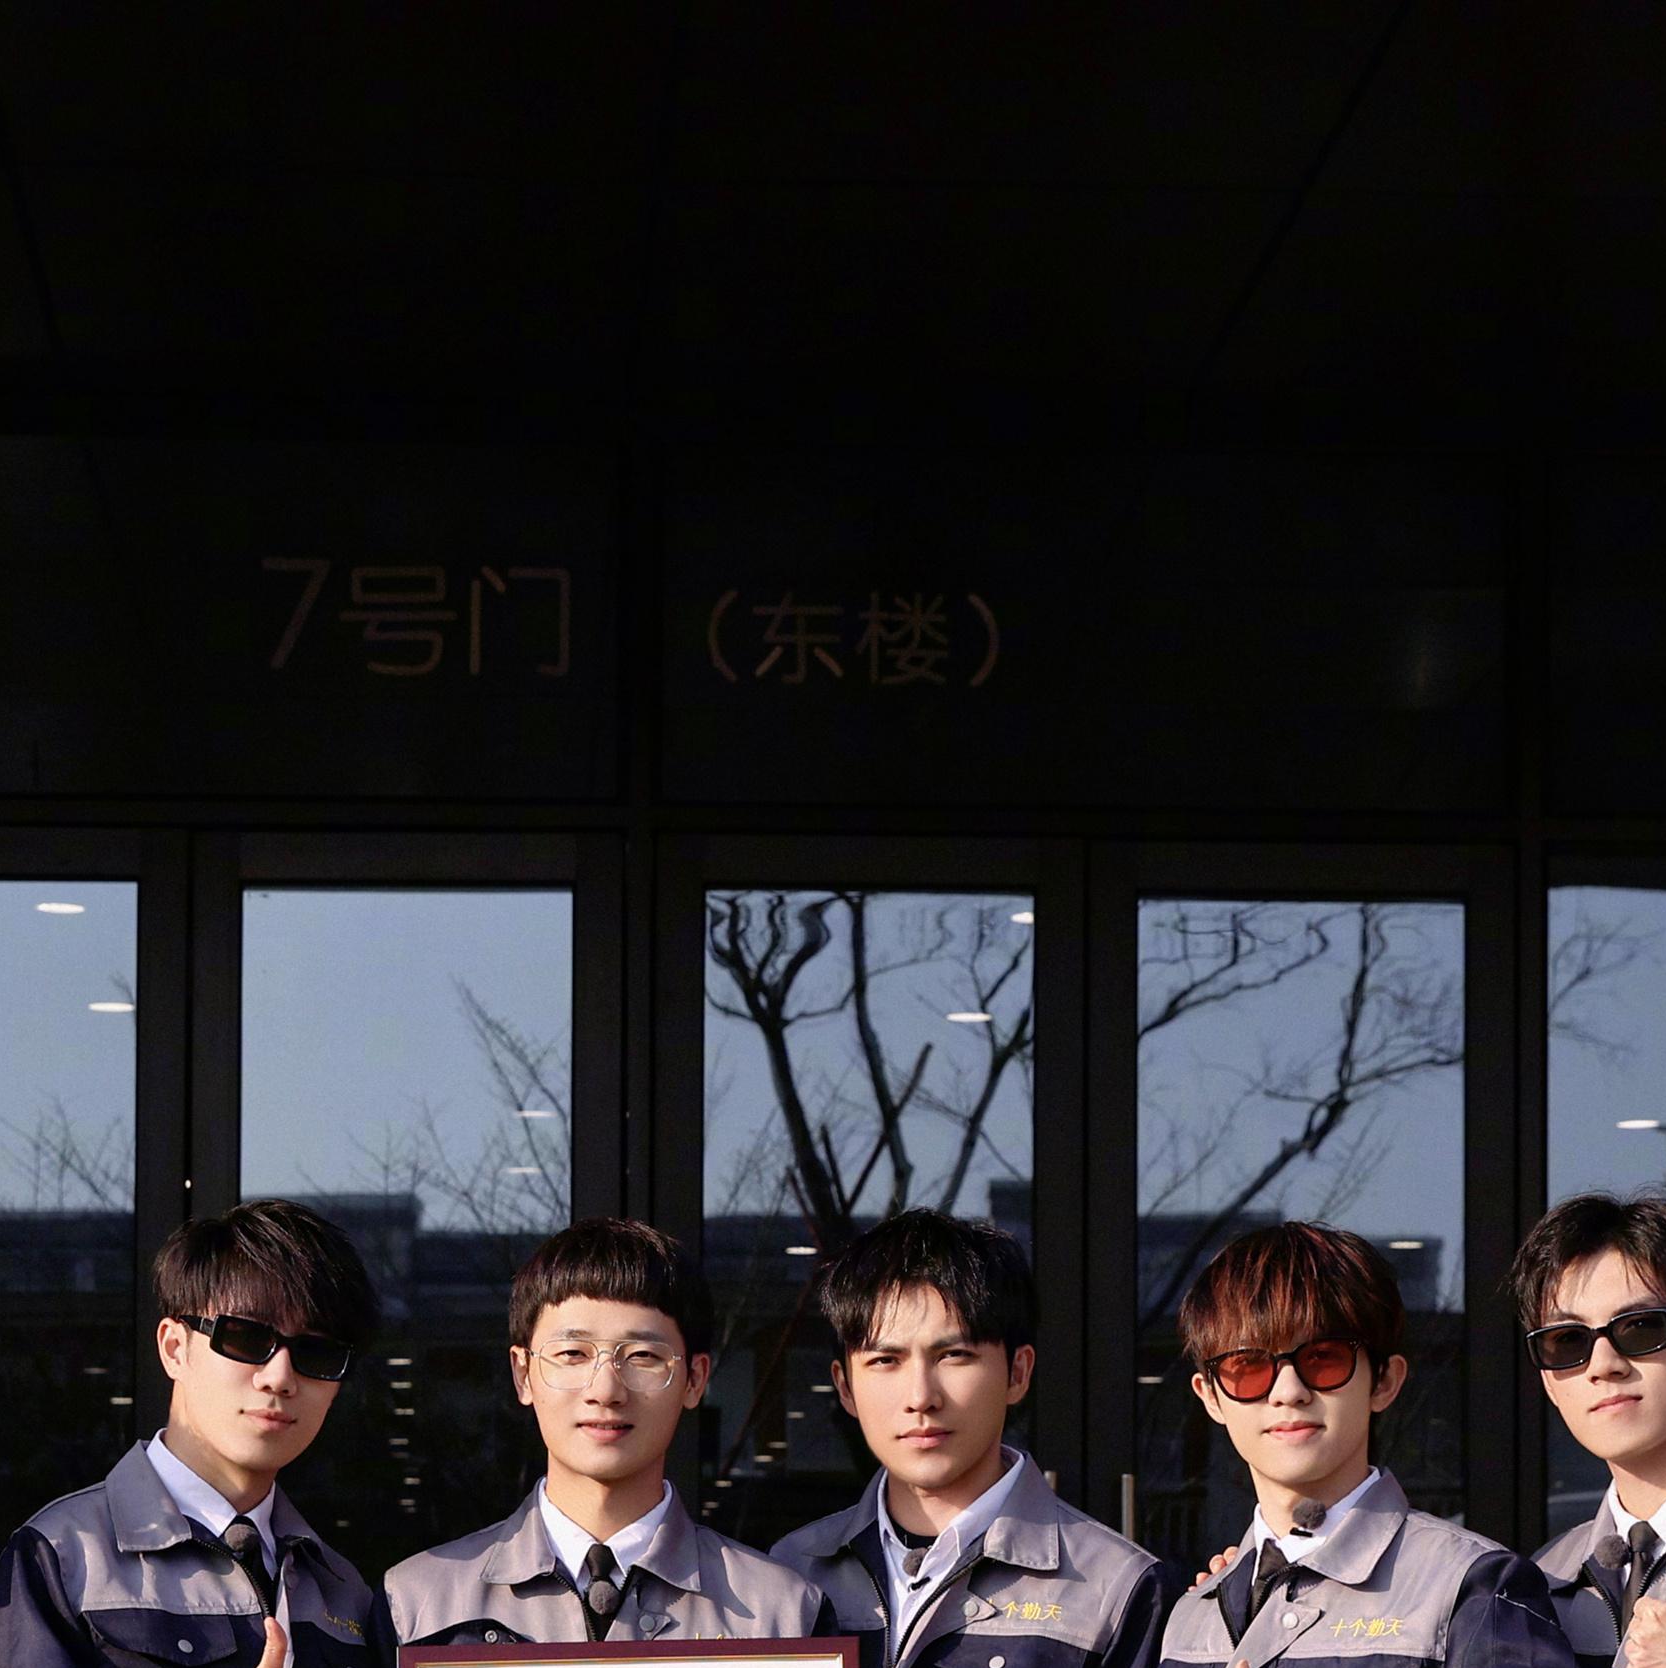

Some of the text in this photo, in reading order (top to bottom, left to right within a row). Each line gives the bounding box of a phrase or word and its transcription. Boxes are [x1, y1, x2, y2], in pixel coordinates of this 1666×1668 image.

[261, 557, 571, 677] 7号门
[986, 1598, 1062, 1621] 个勤天
[1329, 1616, 1405, 1638] 十个勤天
